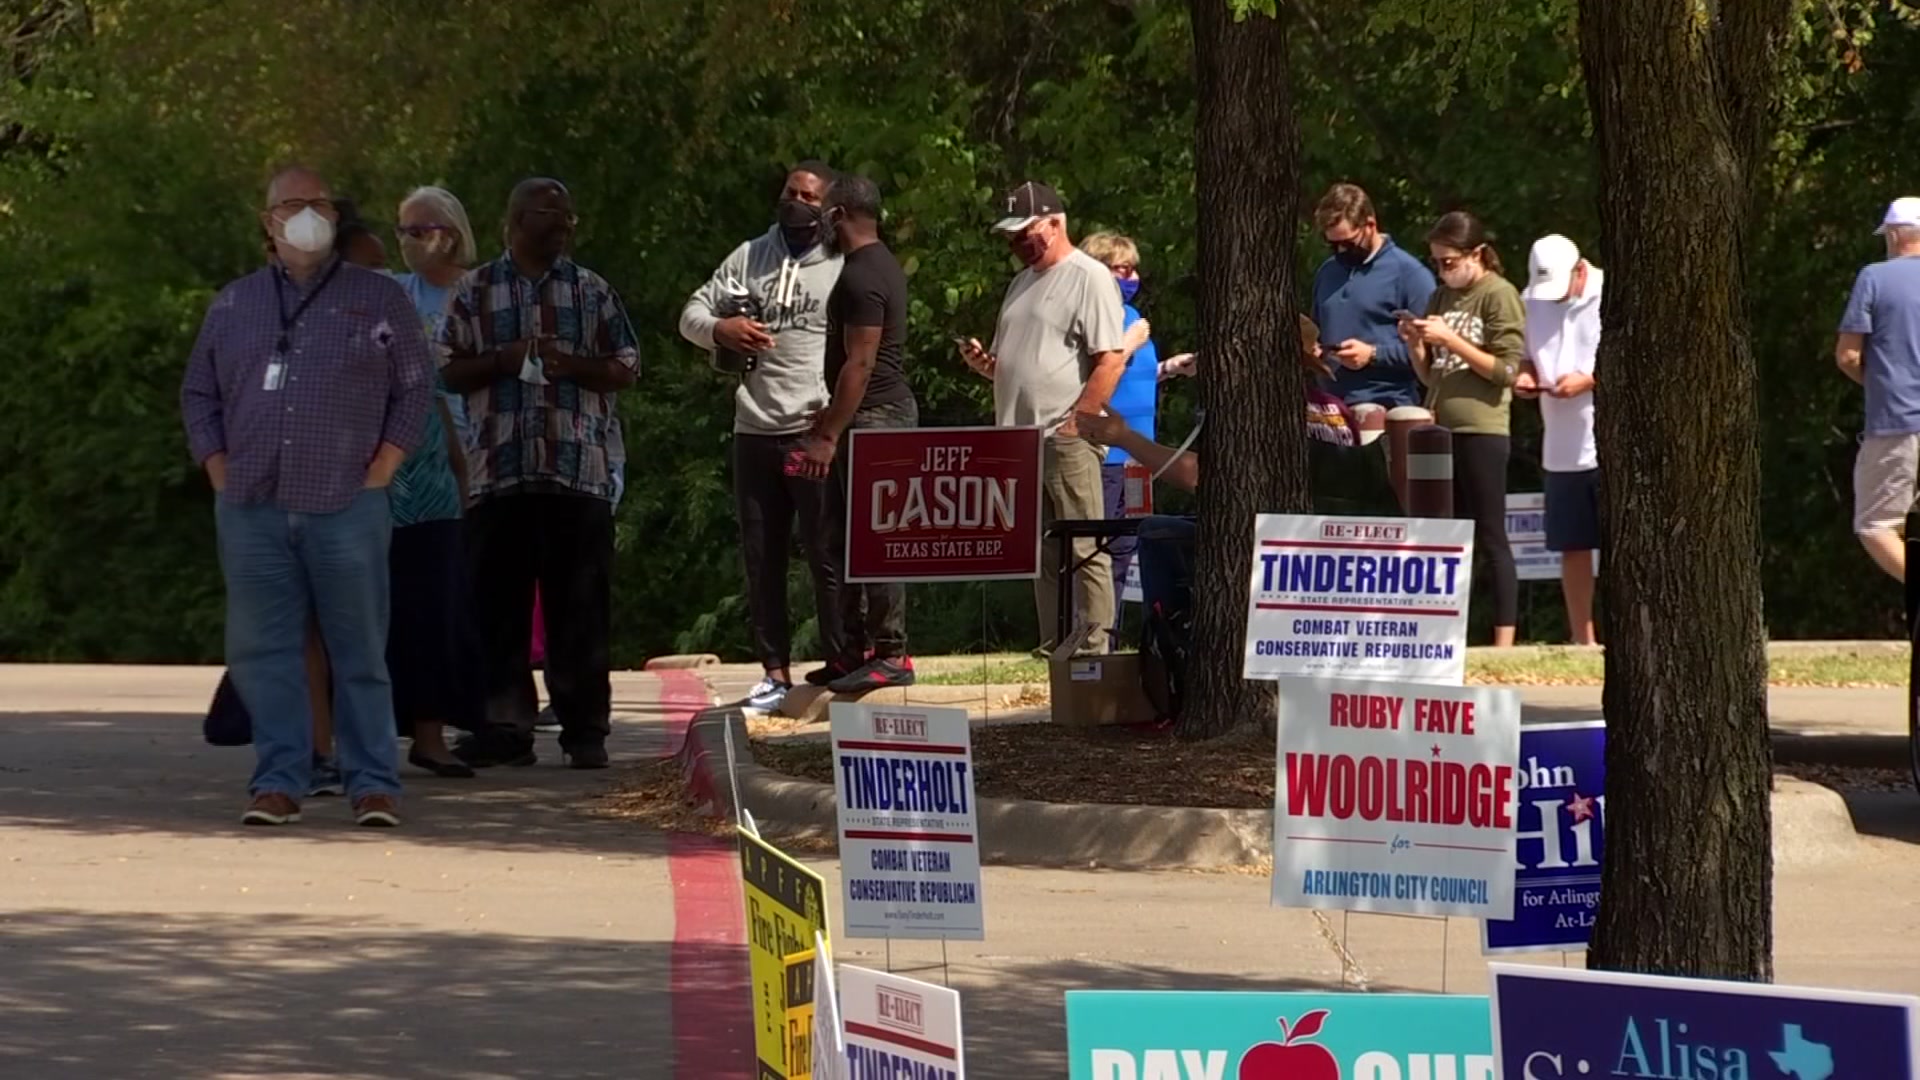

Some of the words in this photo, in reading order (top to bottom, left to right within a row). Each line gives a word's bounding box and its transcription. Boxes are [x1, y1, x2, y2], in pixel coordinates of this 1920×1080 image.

[921, 446, 973, 472] JEFF
[870, 476, 1018, 533] CASON
[1323, 524, 1403, 540] RE-ELECT
[885, 542, 928, 558] TEXAS
[932, 541, 972, 558] STATE
[976, 540, 1003, 556] REP.
[1260, 554, 1460, 595] TINDERHOLT
[1300, 597, 1328, 605] STATE
[1331, 597, 1414, 606] REPRESENTATIVE
[1292, 619, 1350, 636] COMBAT
[1356, 620, 1418, 637] VETERAN
[1256, 640, 1358, 658] CONSERVATIVE
[1365, 642, 1453, 660] REPUBLICAN
[873, 717, 927, 737] RE-ELECT
[1330, 693, 1404, 730] RUBY
[1414, 698, 1475, 735] FAYE
[840, 755, 968, 814] TINDERHOLT
[1517, 756, 1576, 790] ohn
[1285, 752, 1513, 829] WOOLRIDGE
[1390, 834, 1411, 854] for
[1516, 794, 1605, 869] Hi
[871, 849, 908, 871] COMBAT
[911, 850, 951, 873] VETERAN
[850, 879, 917, 902] CONSERVATIVE
[919, 881, 976, 904] REPUBLICAN
[1303, 869, 1391, 899] ARLINGTON
[1394, 873, 1427, 901] CITY
[1431, 876, 1489, 905] COUNCIL
[1522, 890, 1544, 907] for
[749, 895, 774, 955] Fire
[877, 991, 922, 1026] RE-ELECT
[1611, 1015, 1750, 1080] Alisa
